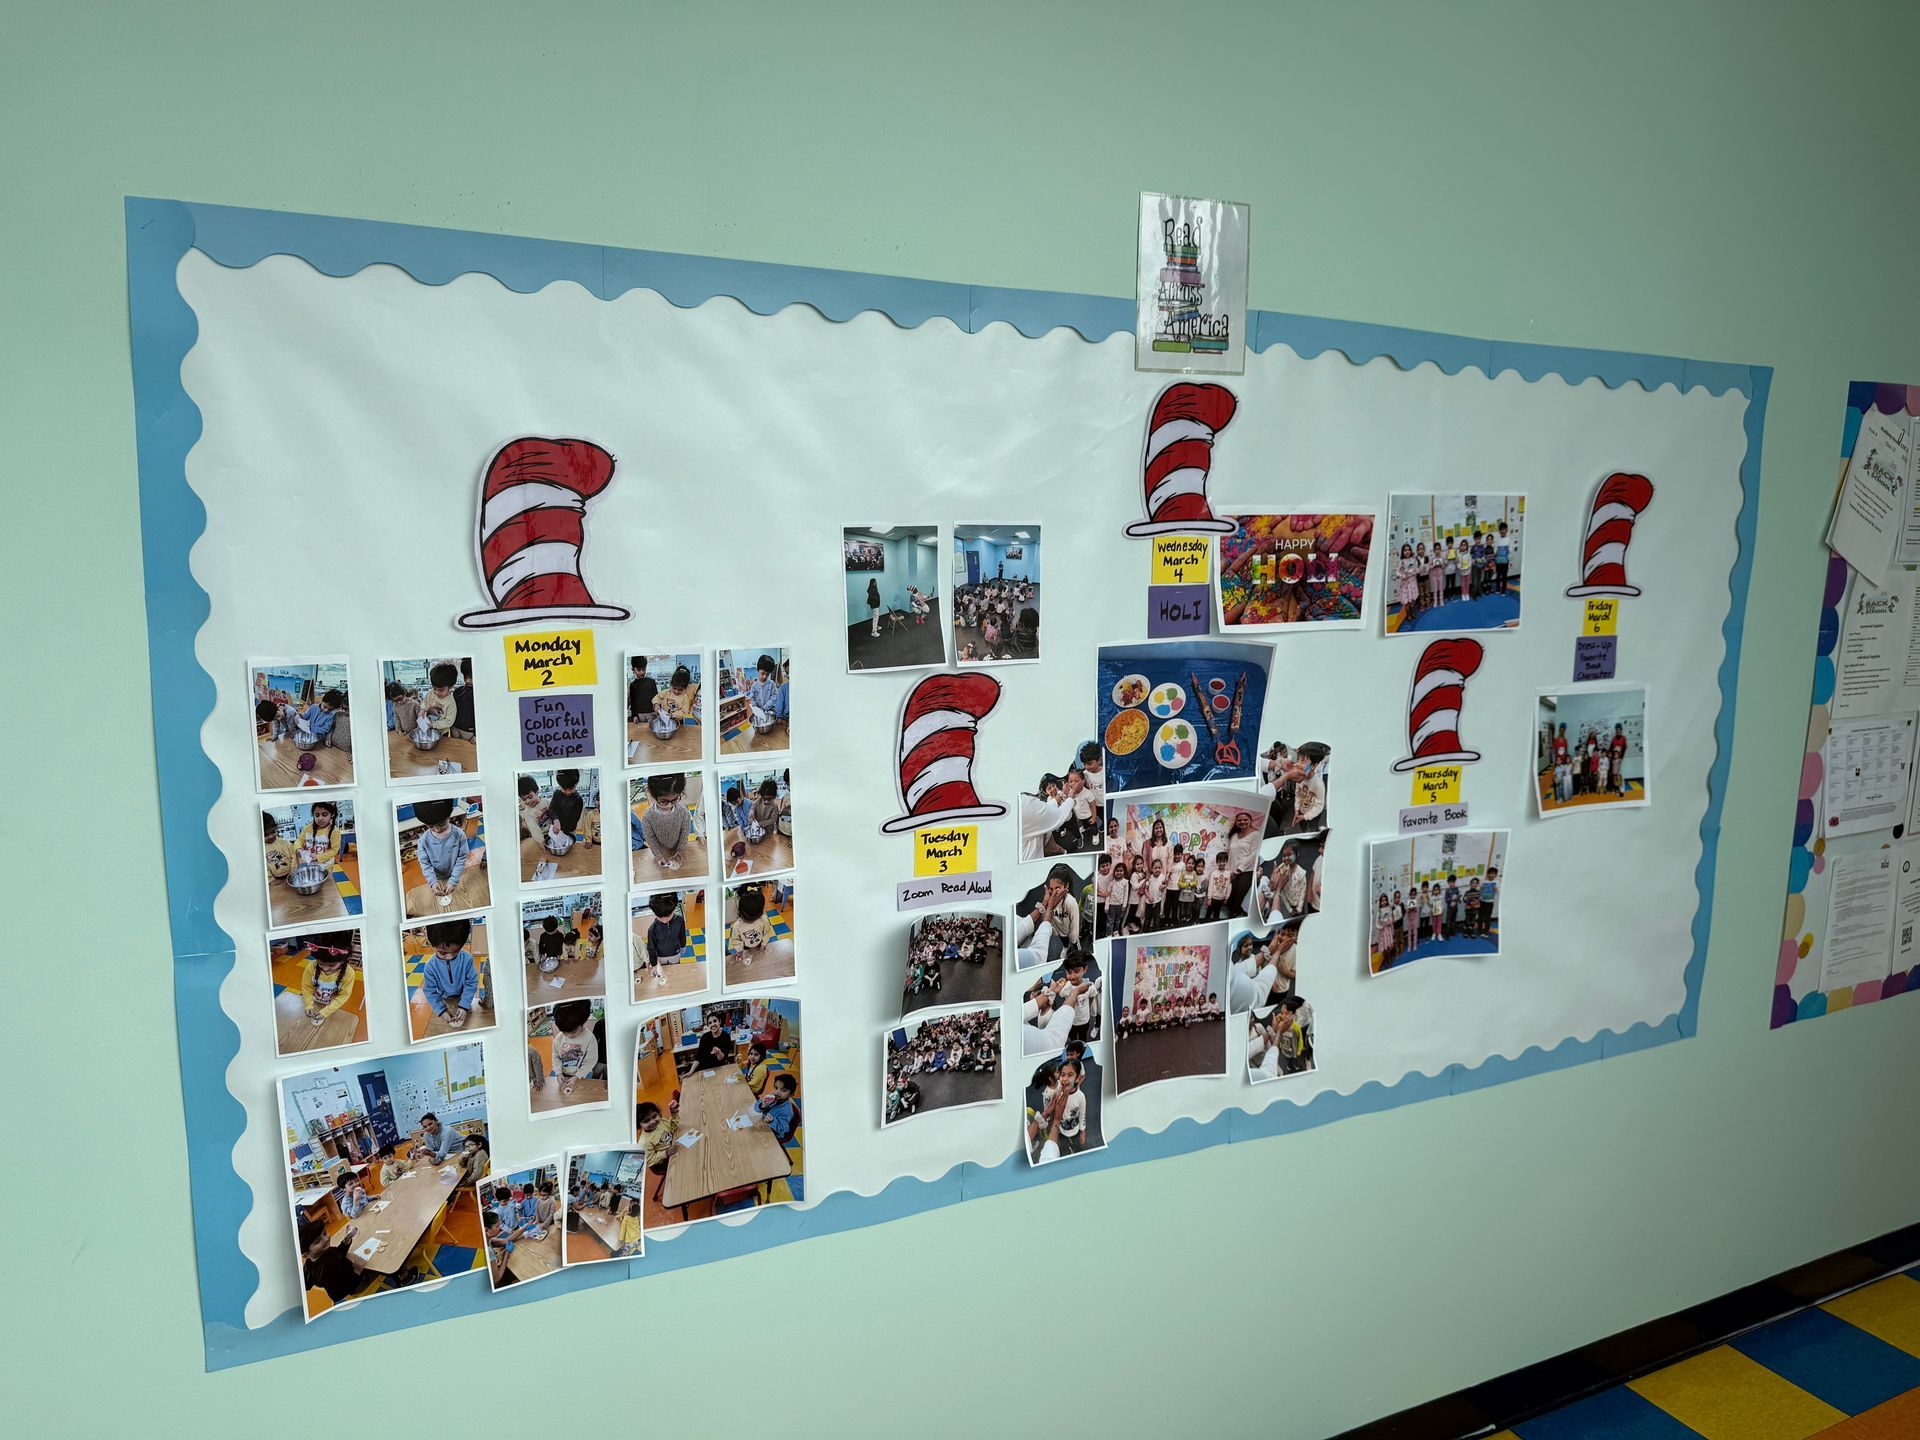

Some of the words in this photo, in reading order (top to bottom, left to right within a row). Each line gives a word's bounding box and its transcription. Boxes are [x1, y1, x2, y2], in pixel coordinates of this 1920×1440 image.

[1163, 216, 1203, 254] Read
[1158, 283, 1203, 308] Across
[1164, 309, 1229, 342] America
[1158, 539, 1208, 559] Wednesday
[1275, 538, 1315, 551] HAPPY
[1163, 553, 1198, 566] March
[1174, 567, 1184, 583] 4
[1251, 552, 1339, 584] HOLI
[1160, 600, 1202, 621] HOLI
[1588, 601, 1613, 616] Friday
[1588, 612, 1610, 621] March
[1594, 622, 1600, 633] 6
[515, 636, 581, 656] Monday
[524, 653, 573, 671] March
[540, 669, 555, 686] 2
[534, 698, 565, 713] Fun
[526, 728, 589, 748] Cupcake
[536, 743, 583, 758] Recipe
[1417, 768, 1458, 782] Thursday
[1422, 779, 1448, 791] March
[1430, 792, 1437, 803] 5
[1402, 811, 1438, 828] Favorite
[1444, 808, 1468, 821] Book
[921, 830, 969, 846] Tuesday
[1170, 829, 1216, 851] APPY
[926, 846, 962, 859] March
[939, 860, 948, 873] 3
[902, 890, 934, 902] Zoom
[941, 880, 966, 893] Read
[967, 880, 992, 895] Aloud
[1155, 961, 1193, 977] HAPPY
[1158, 975, 1188, 991] HOLI
